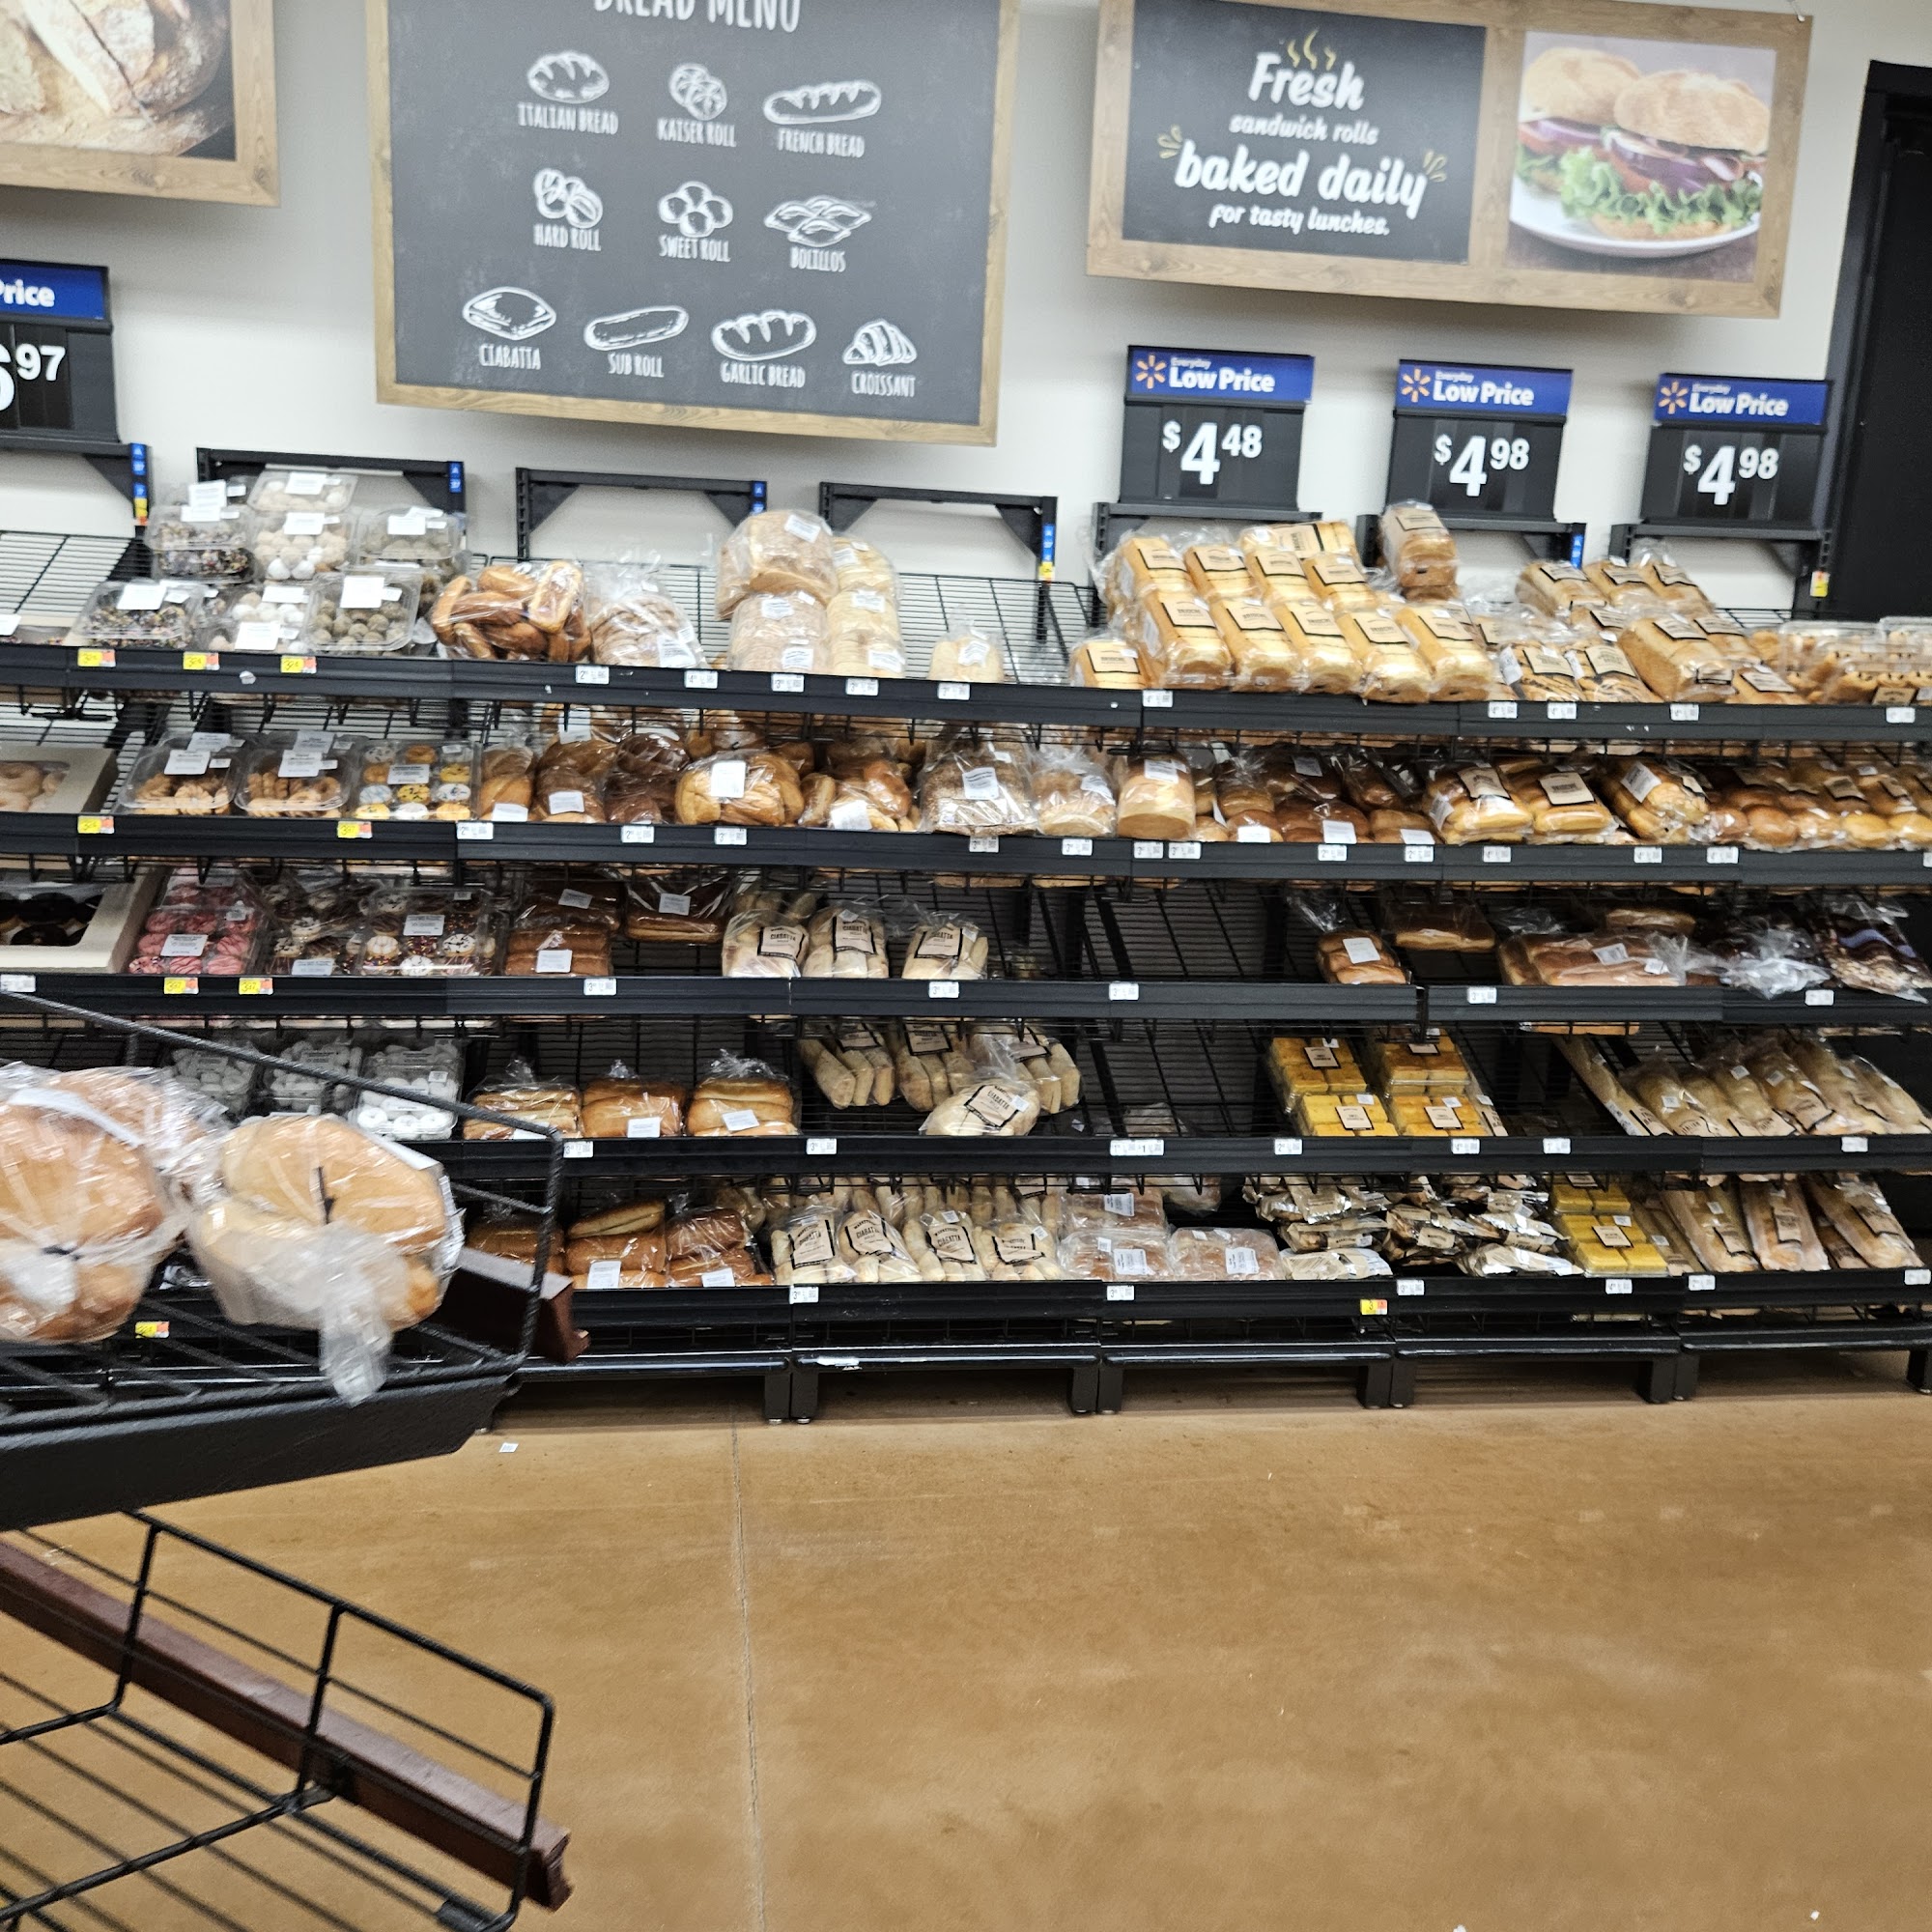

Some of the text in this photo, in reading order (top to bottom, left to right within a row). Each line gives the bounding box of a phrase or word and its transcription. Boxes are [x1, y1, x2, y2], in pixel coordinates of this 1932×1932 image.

[1248, 52, 1364, 111] Fresh
[518, 101, 619, 135] ITALIAN BREAD
[1229, 112, 1379, 146] sandwich rolls
[657, 118, 737, 148] KAISER ROLL
[778, 128, 866, 158] FRENCH BREAD
[1174, 139, 1429, 220] baked daily
[1208, 203, 1390, 236] for tasty lunches.
[533, 223, 602, 252] HARD ROLL
[659, 235, 731, 263] SWEET ROLL
[789, 246, 846, 273] BOLILLOS
[0, 279, 55, 307] rice
[478, 344, 541, 371] CIABATTA
[608, 352, 664, 379] SUB ROLL
[1170, 356, 1211, 369] Everyday
[720, 361, 806, 388] GARLIC BREAD
[851, 371, 917, 398] CROISSANT
[1169, 367, 1276, 393] Low Price
[1433, 380, 1535, 407] Low Price
[1689, 392, 1789, 417] Low Price
